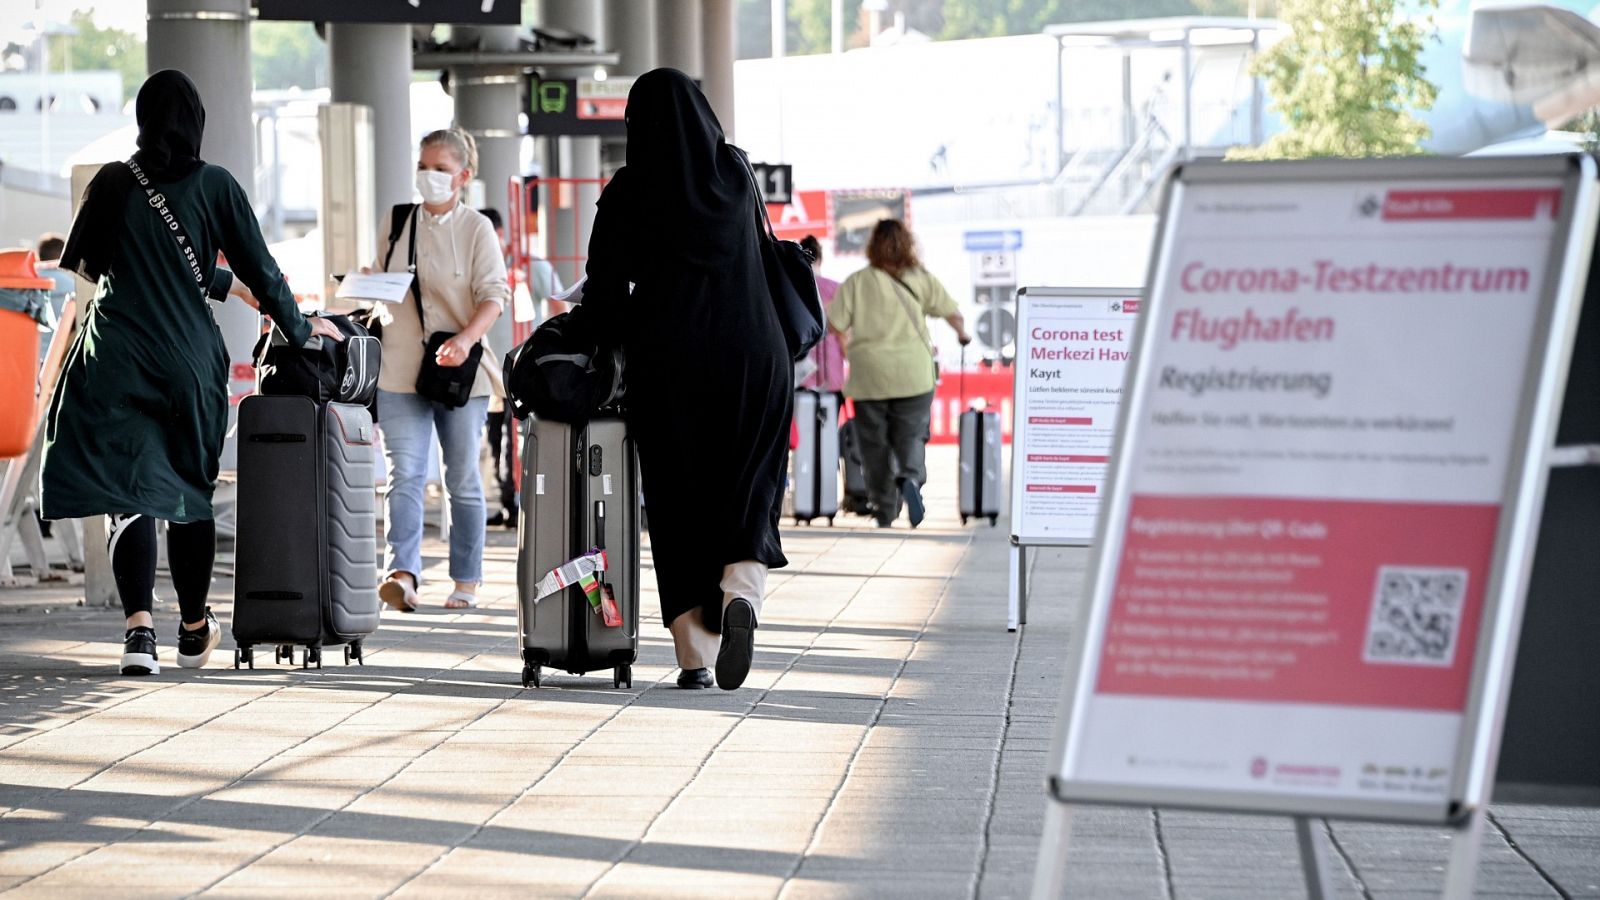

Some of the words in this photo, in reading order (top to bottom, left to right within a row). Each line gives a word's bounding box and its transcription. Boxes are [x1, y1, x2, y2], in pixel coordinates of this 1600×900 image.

[127, 159, 149, 186] GUESS
[184, 246, 203, 282] GUESS
[1180, 260, 1530, 294] Corona-Testzentrum
[1031, 327, 1089, 341] Corona
[1094, 329, 1123, 341] test
[1170, 307, 1335, 350] Flughafen
[1031, 347, 1095, 361] Merkezi
[1030, 368, 1062, 380] Kayıt
[1158, 366, 1333, 399] Registrierung
